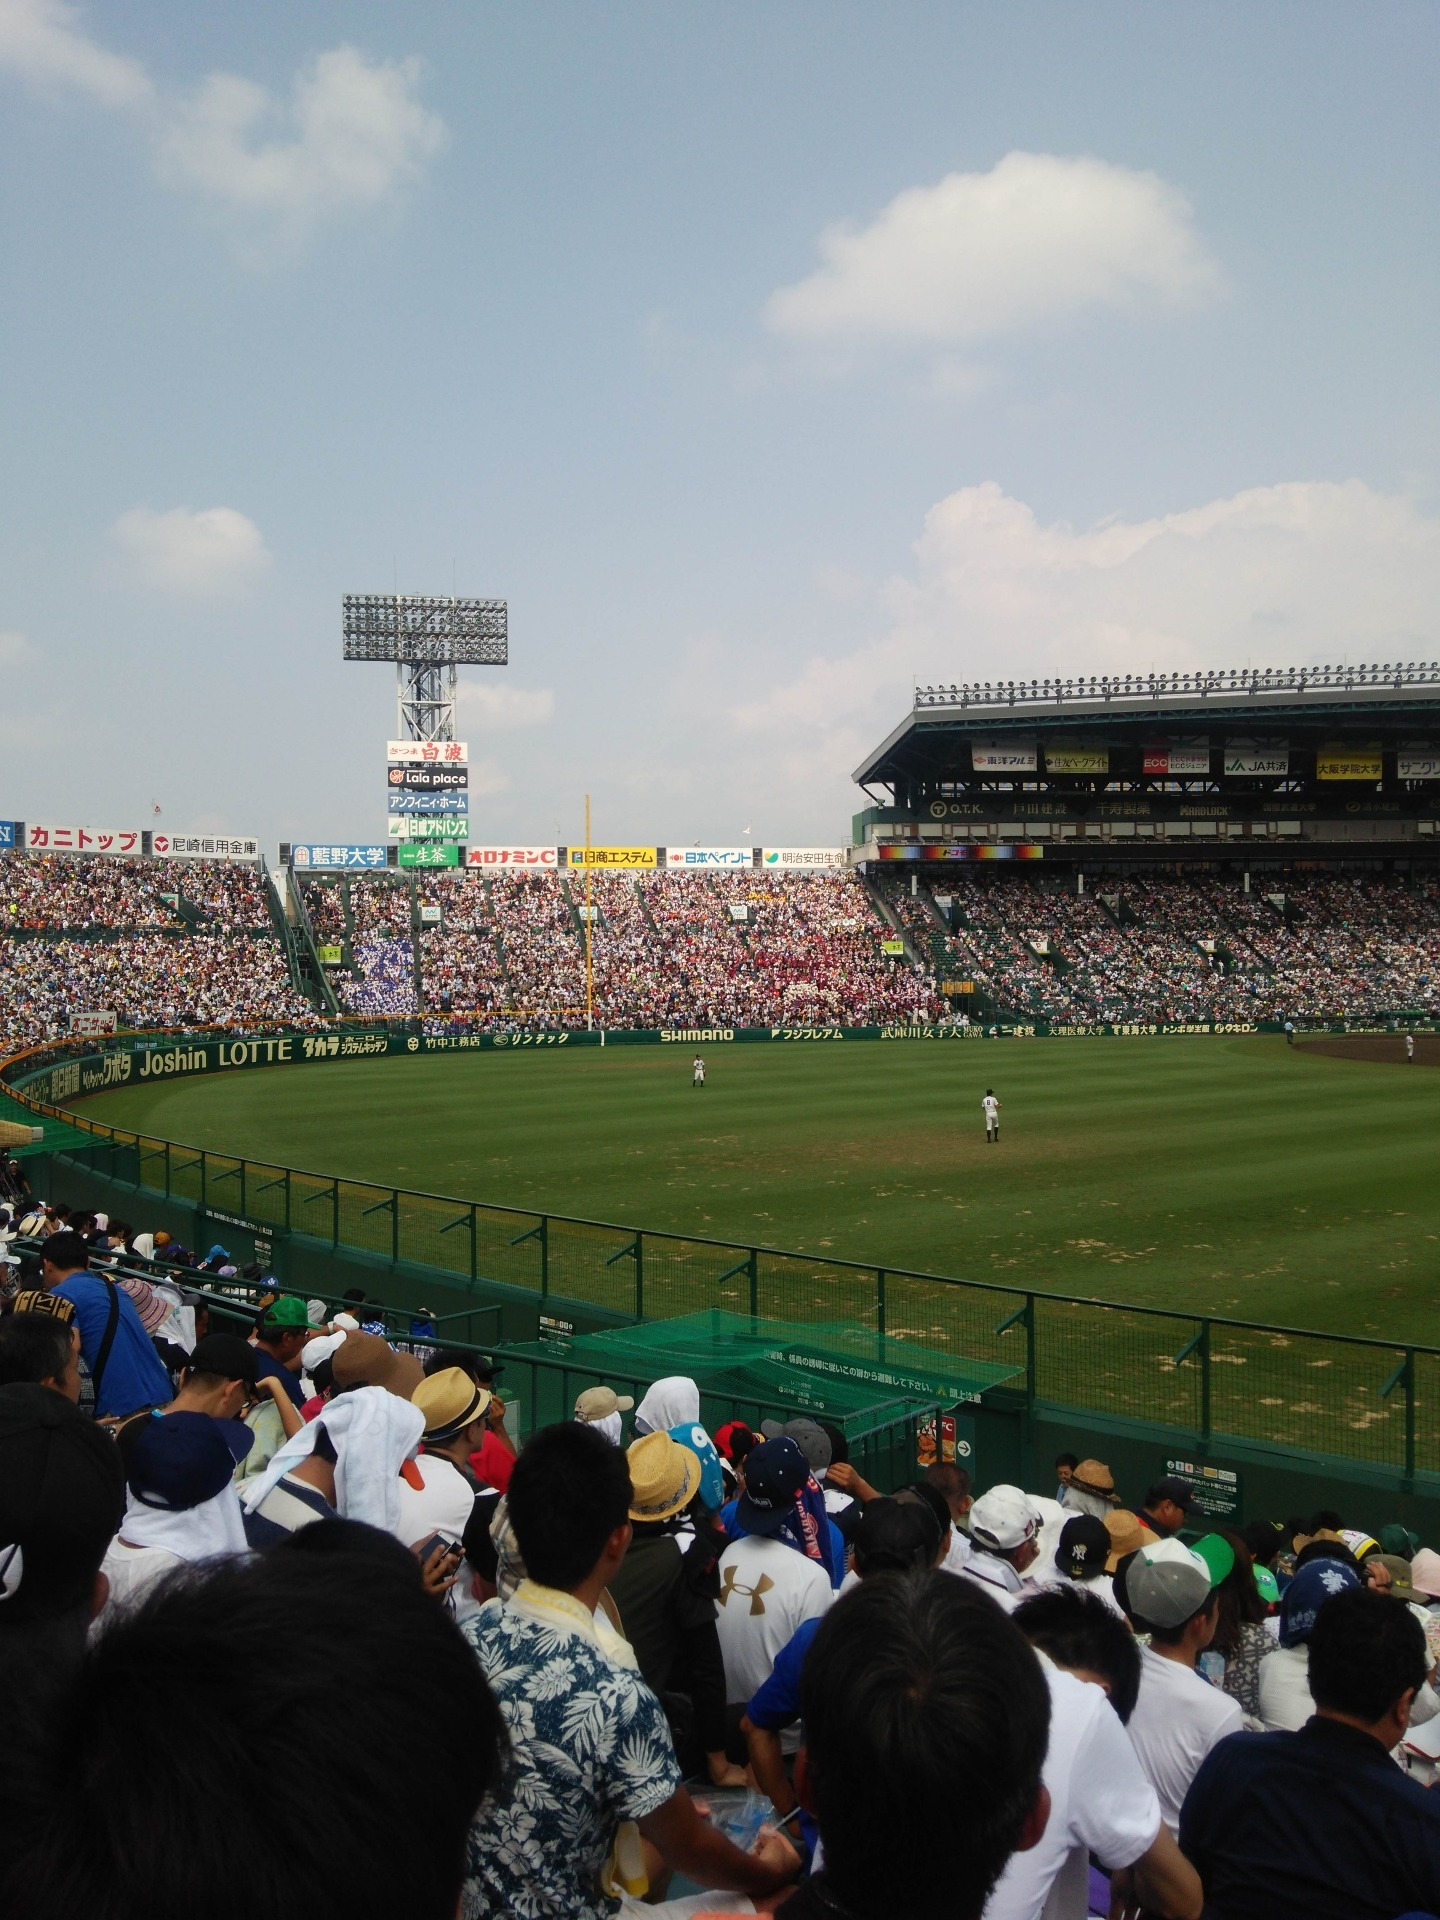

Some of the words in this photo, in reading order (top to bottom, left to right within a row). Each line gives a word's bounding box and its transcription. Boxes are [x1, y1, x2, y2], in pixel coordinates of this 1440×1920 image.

[389, 747, 418, 755] さつま
[421, 742, 464, 761] 白波
[987, 756, 1035, 765] 東洋アルミ
[1054, 757, 1108, 768] 住友ベークライト
[1144, 758, 1168, 767] ECC
[1248, 761, 1287, 772] JA共済
[1318, 764, 1382, 774] 大阪学院大学
[406, 772, 430, 783] Lala
[433, 773, 467, 785] place
[950, 804, 984, 814] O.T.K.
[1013, 803, 1067, 815] 戸田建設
[1096, 801, 1152, 815] 千寿製薬
[30, 826, 138, 851] カニトップ
[172, 837, 257, 855] 尼崎信用金庫
[312, 846, 384, 865] 藍野大学
[416, 847, 447, 863] 生茶
[468, 850, 556, 863] オロナミンC
[585, 851, 654, 863] 日商エステム
[685, 851, 751, 864] 日本ペイント
[782, 852, 843, 864] 明治安田生命
[783, 1028, 843, 1040] フジプレアム
[881, 1026, 961, 1039] 武庫川女子大
[1048, 1025, 1106, 1036] 天理医療大学
[1122, 1025, 1158, 1035] 東海大学
[1225, 1023, 1259, 1033] タキロン
[511, 1032, 569, 1045] リンテック
[660, 1029, 734, 1041] SHIMANO
[302, 1036, 340, 1058] タカラ
[341, 1040, 388, 1055] システムキッチン
[426, 1035, 481, 1049] 竹中工務店
[219, 1038, 292, 1066] LOTTE
[103, 1053, 132, 1084] クボタ
[140, 1047, 207, 1077] Joshin
